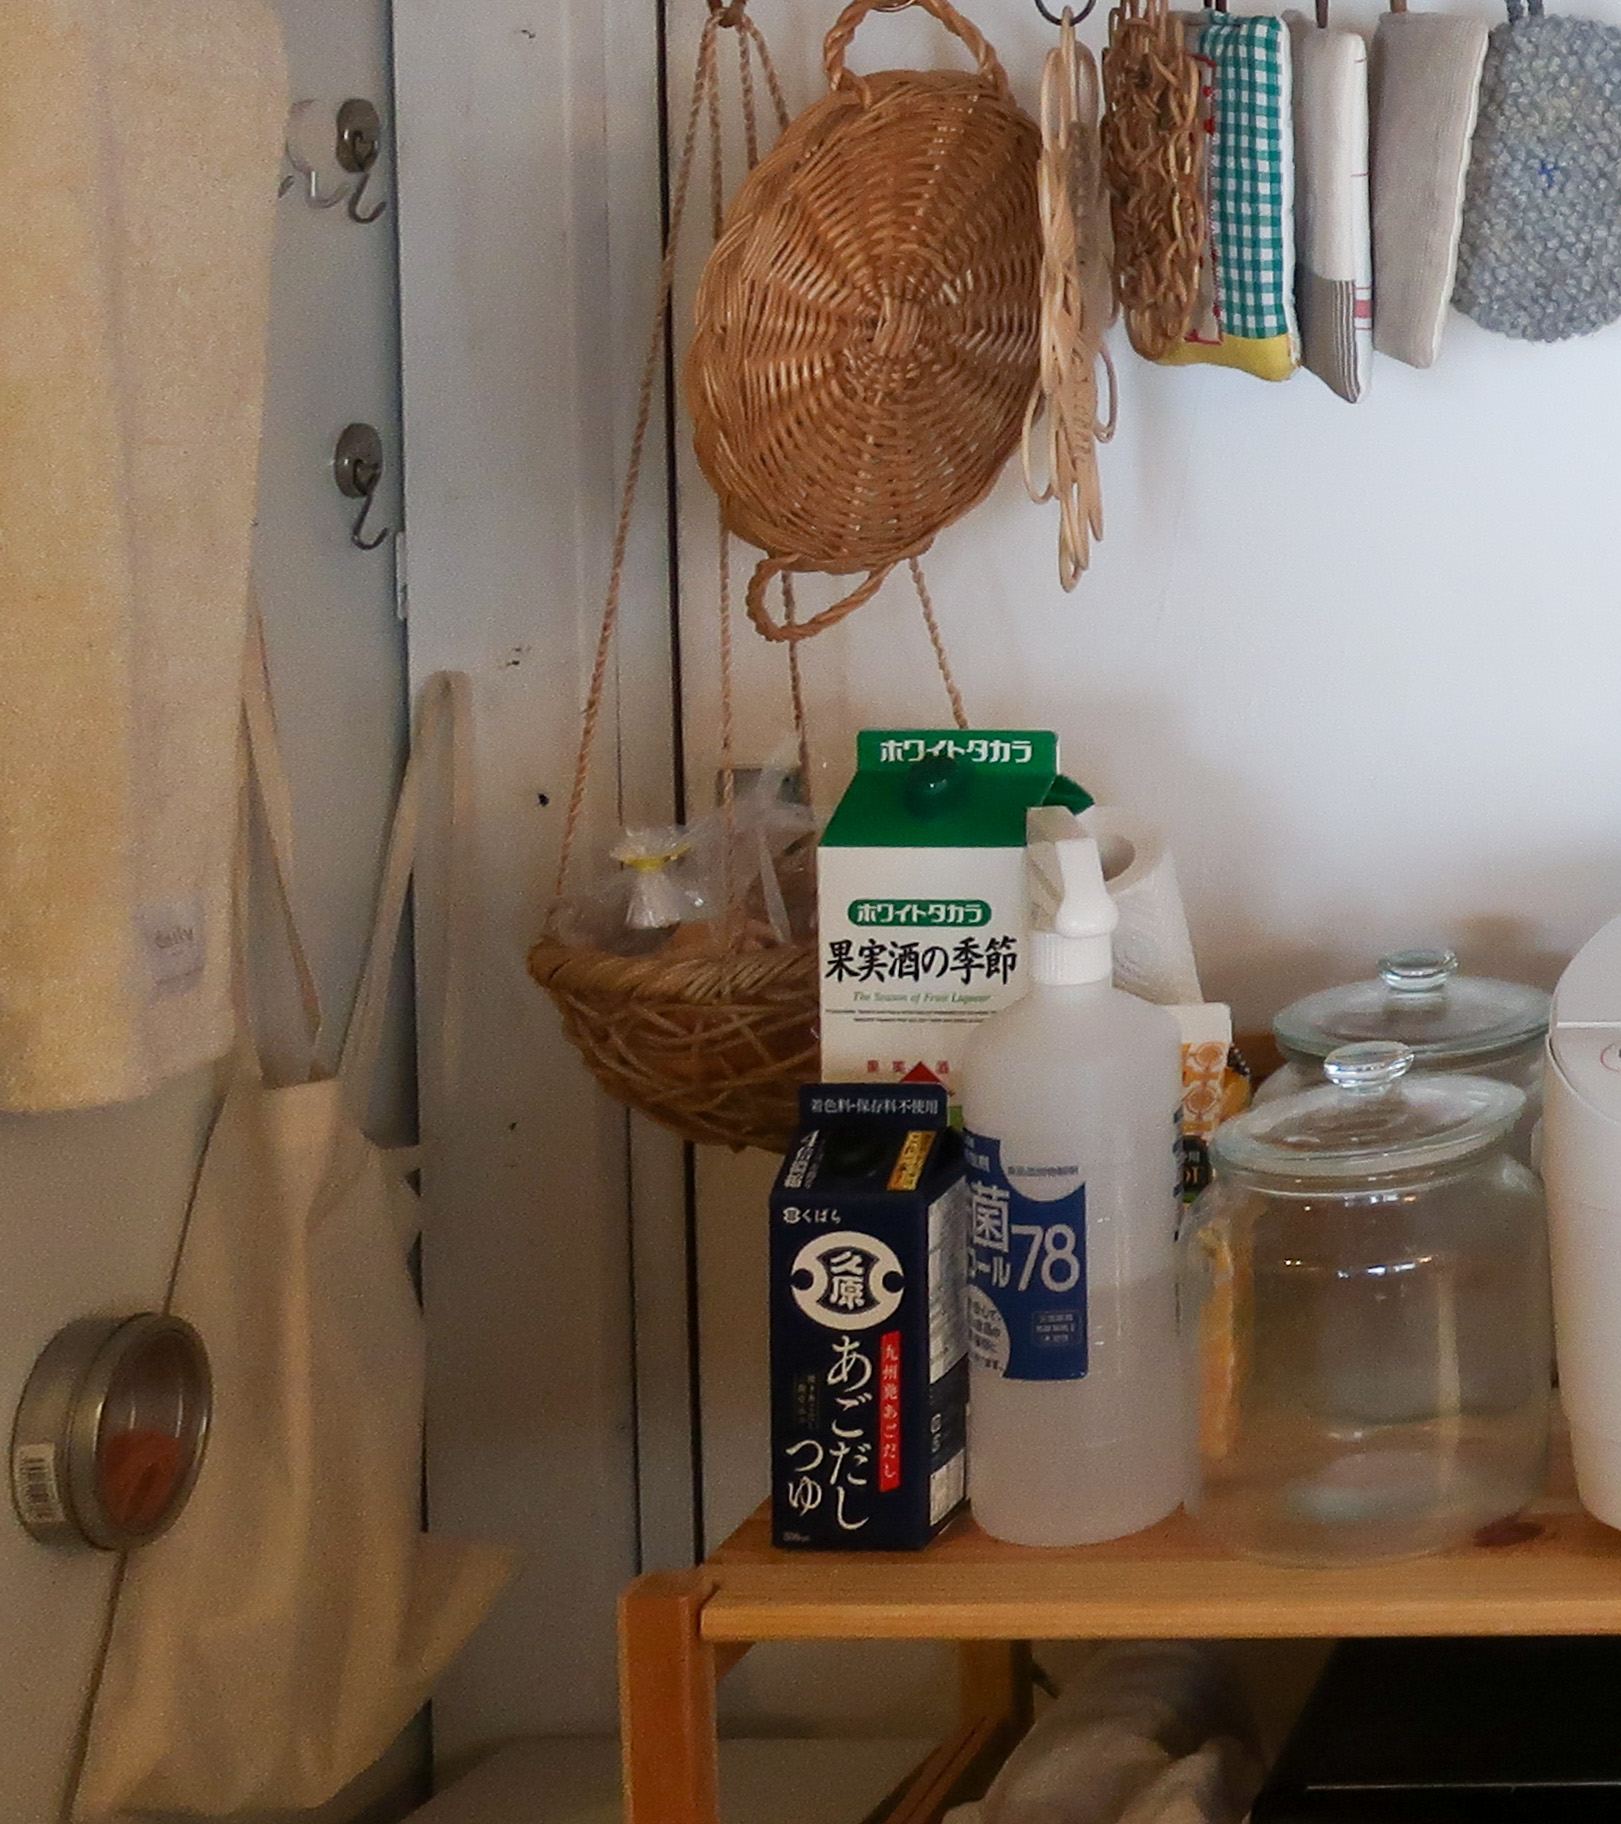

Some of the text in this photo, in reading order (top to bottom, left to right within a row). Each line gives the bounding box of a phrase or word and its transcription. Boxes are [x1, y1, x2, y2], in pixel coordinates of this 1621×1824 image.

[880, 739, 1033, 763] ホワイトタカラ
[856, 904, 983, 924] ホワイトタカラ
[825, 935, 1018, 985] 果実酒の季節
[802, 1208, 842, 1224] くばら
[1011, 1224, 1081, 1293] 78
[826, 1335, 873, 1531] あごだし
[785, 1439, 825, 1517] つゆ
